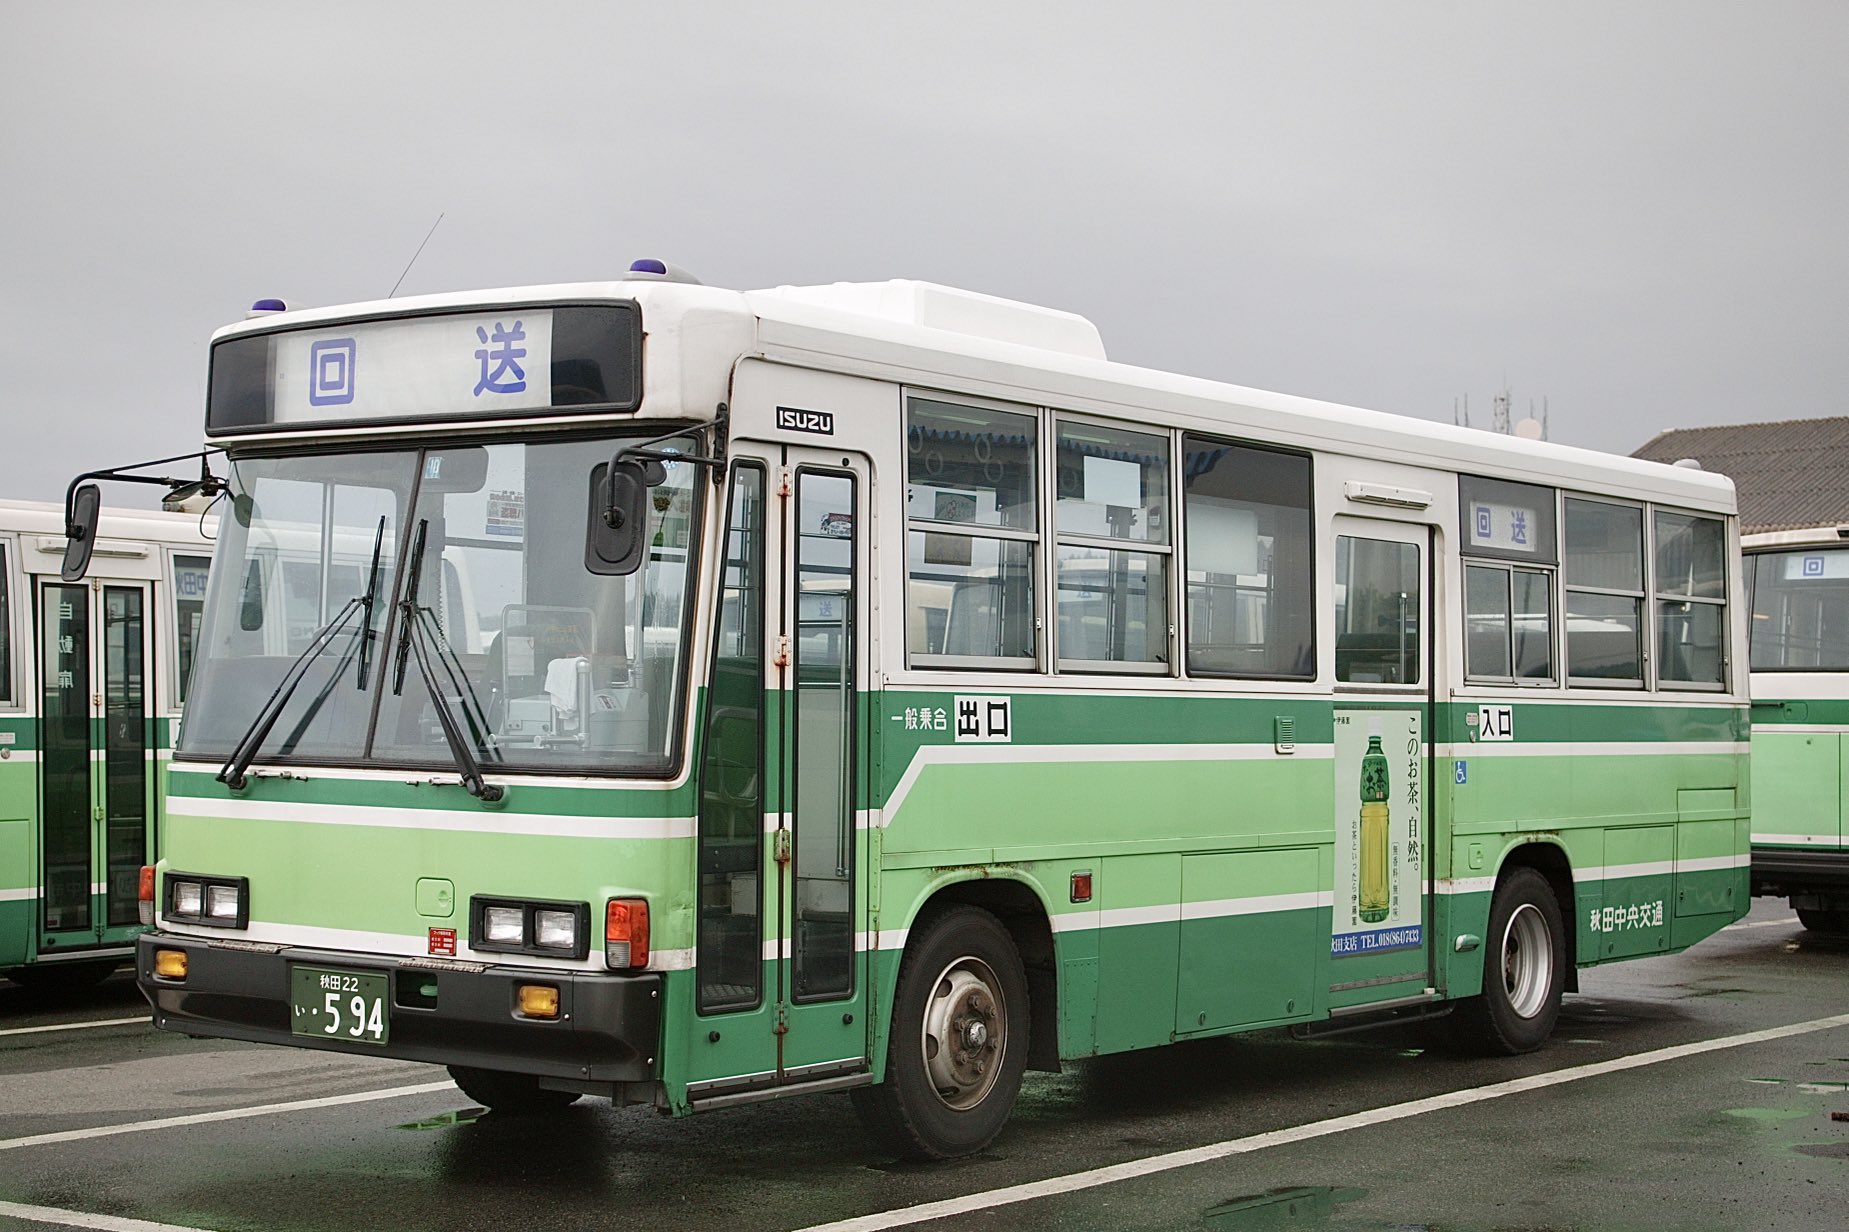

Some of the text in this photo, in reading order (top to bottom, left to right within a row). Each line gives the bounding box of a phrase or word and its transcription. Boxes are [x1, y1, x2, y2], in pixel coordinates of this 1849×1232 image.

[310, 320, 528, 407] 回送
[779, 410, 831, 431] ISUZU
[1476, 506, 1527, 544] 回送
[1803, 556, 1825, 577] 回
[891, 706, 947, 730] 一般乗合
[957, 700, 1008, 737] 出口
[1481, 709, 1512, 737] 入口
[1407, 716, 1419, 872] このお茶、自然。
[1589, 900, 1663, 932] 秋田中央交通
[320, 974, 359, 992] 秋田22
